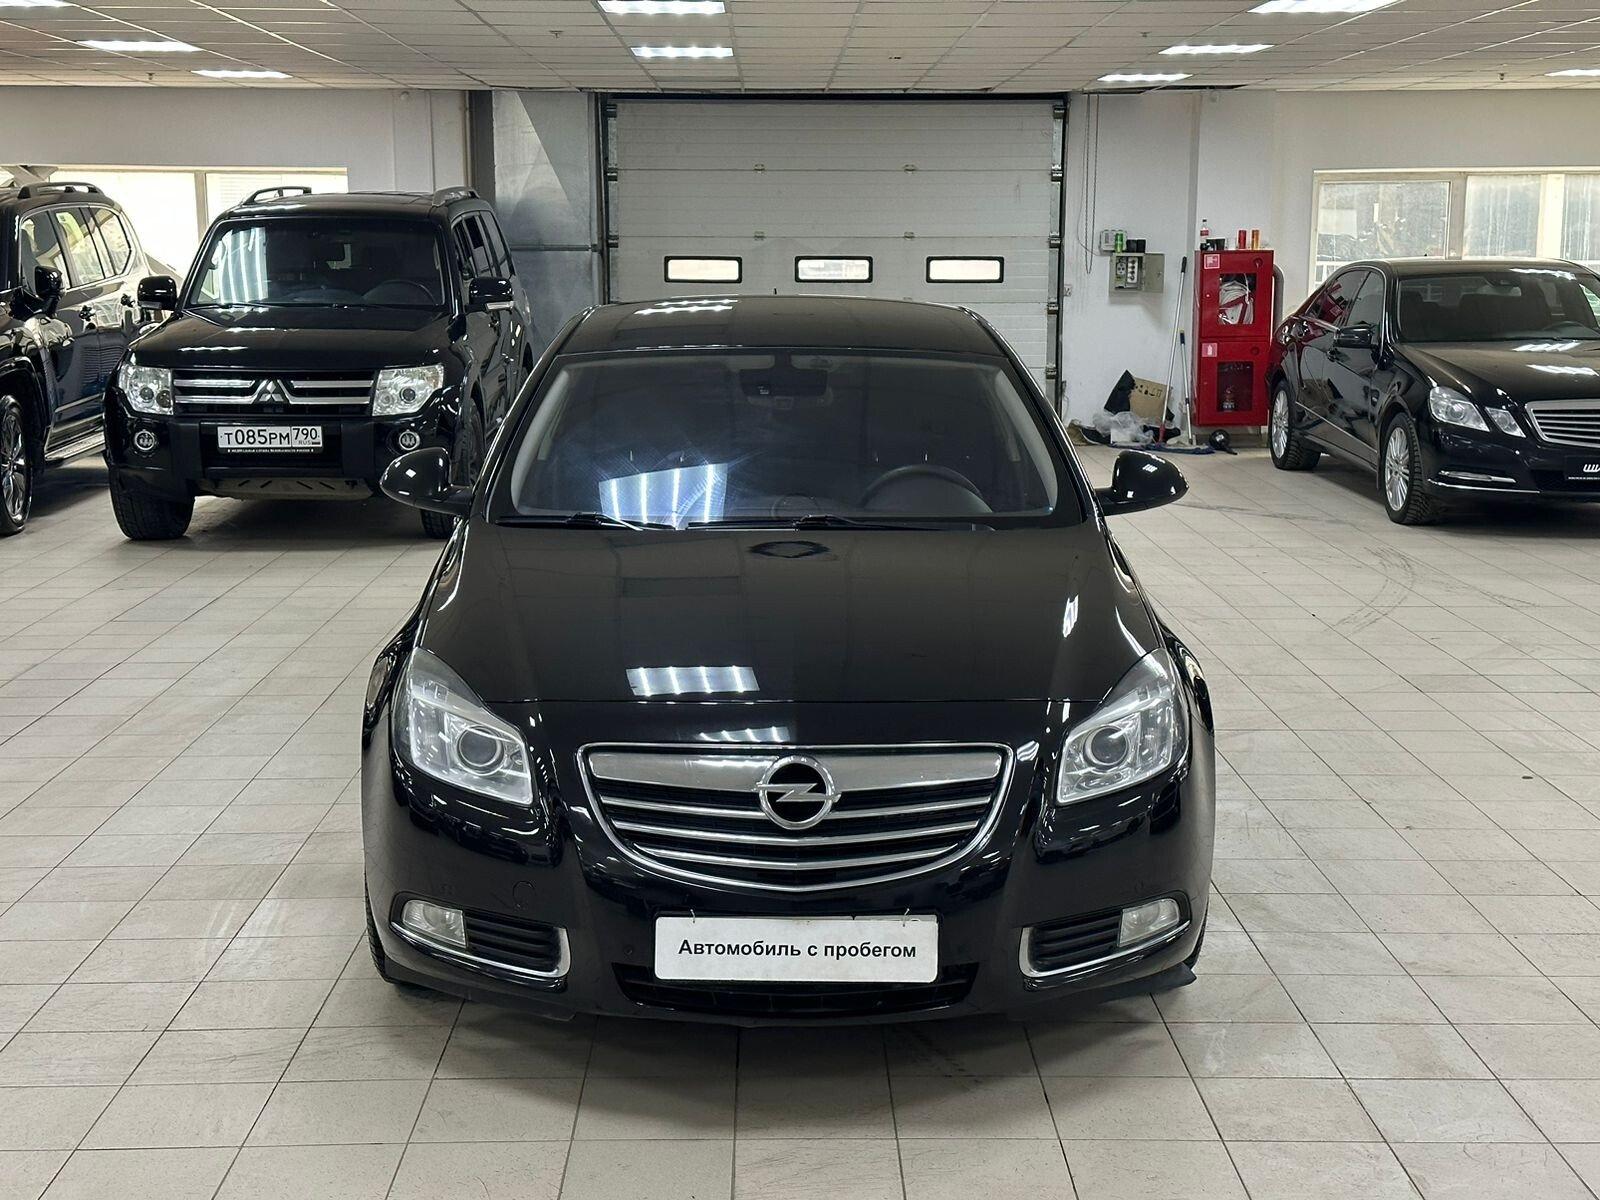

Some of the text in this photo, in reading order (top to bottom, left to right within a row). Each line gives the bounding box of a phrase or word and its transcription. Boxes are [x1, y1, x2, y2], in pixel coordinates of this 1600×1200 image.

[292, 428, 318, 440] 790
[678, 939, 917, 960] Автомобиль с пробегом
